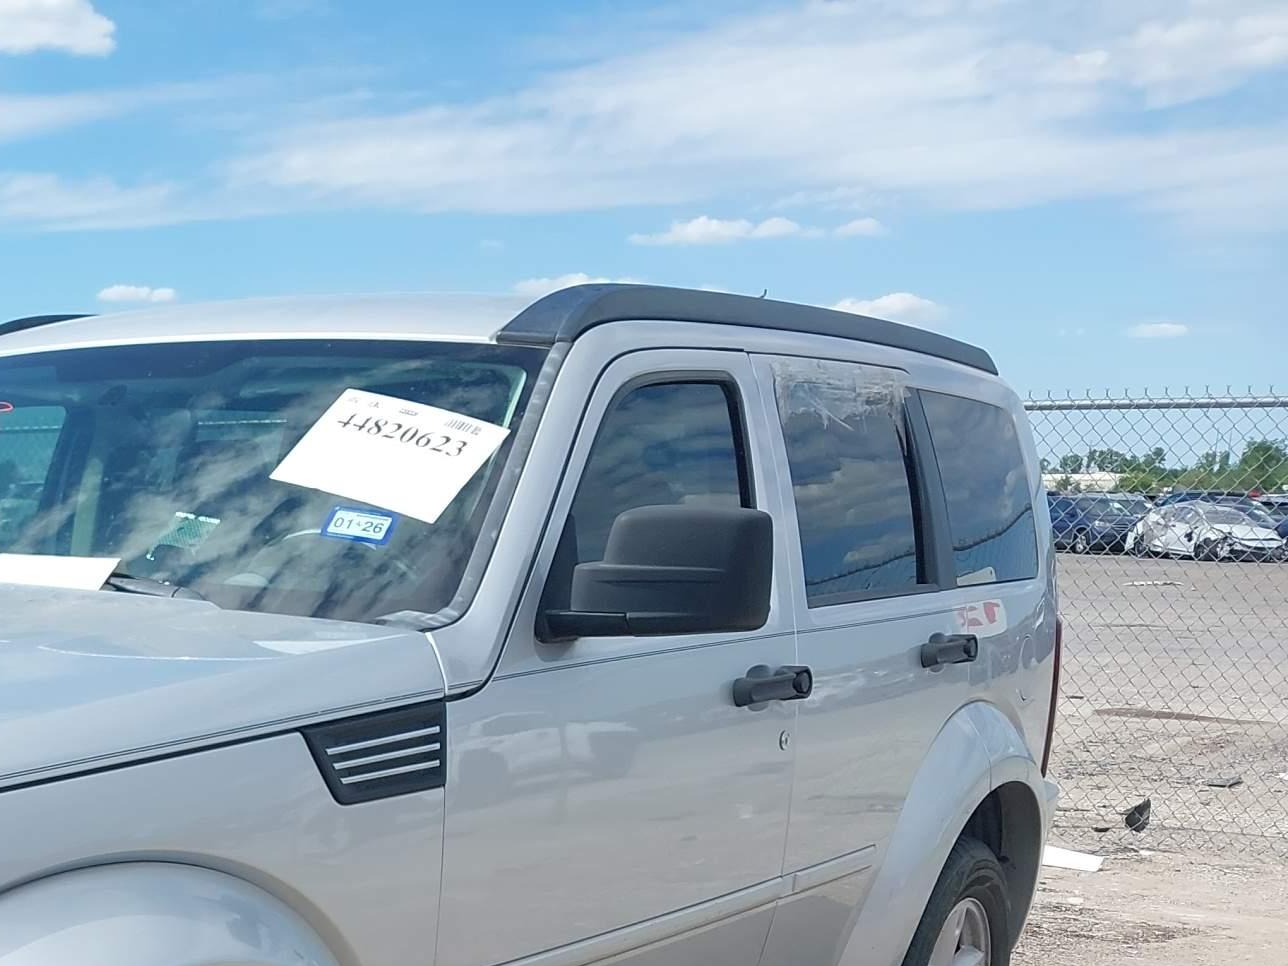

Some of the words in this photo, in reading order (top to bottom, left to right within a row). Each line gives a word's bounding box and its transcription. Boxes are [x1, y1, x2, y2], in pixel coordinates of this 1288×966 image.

[337, 412, 468, 457] 44820623
[334, 517, 354, 529] 01
[361, 521, 385, 534] 26
